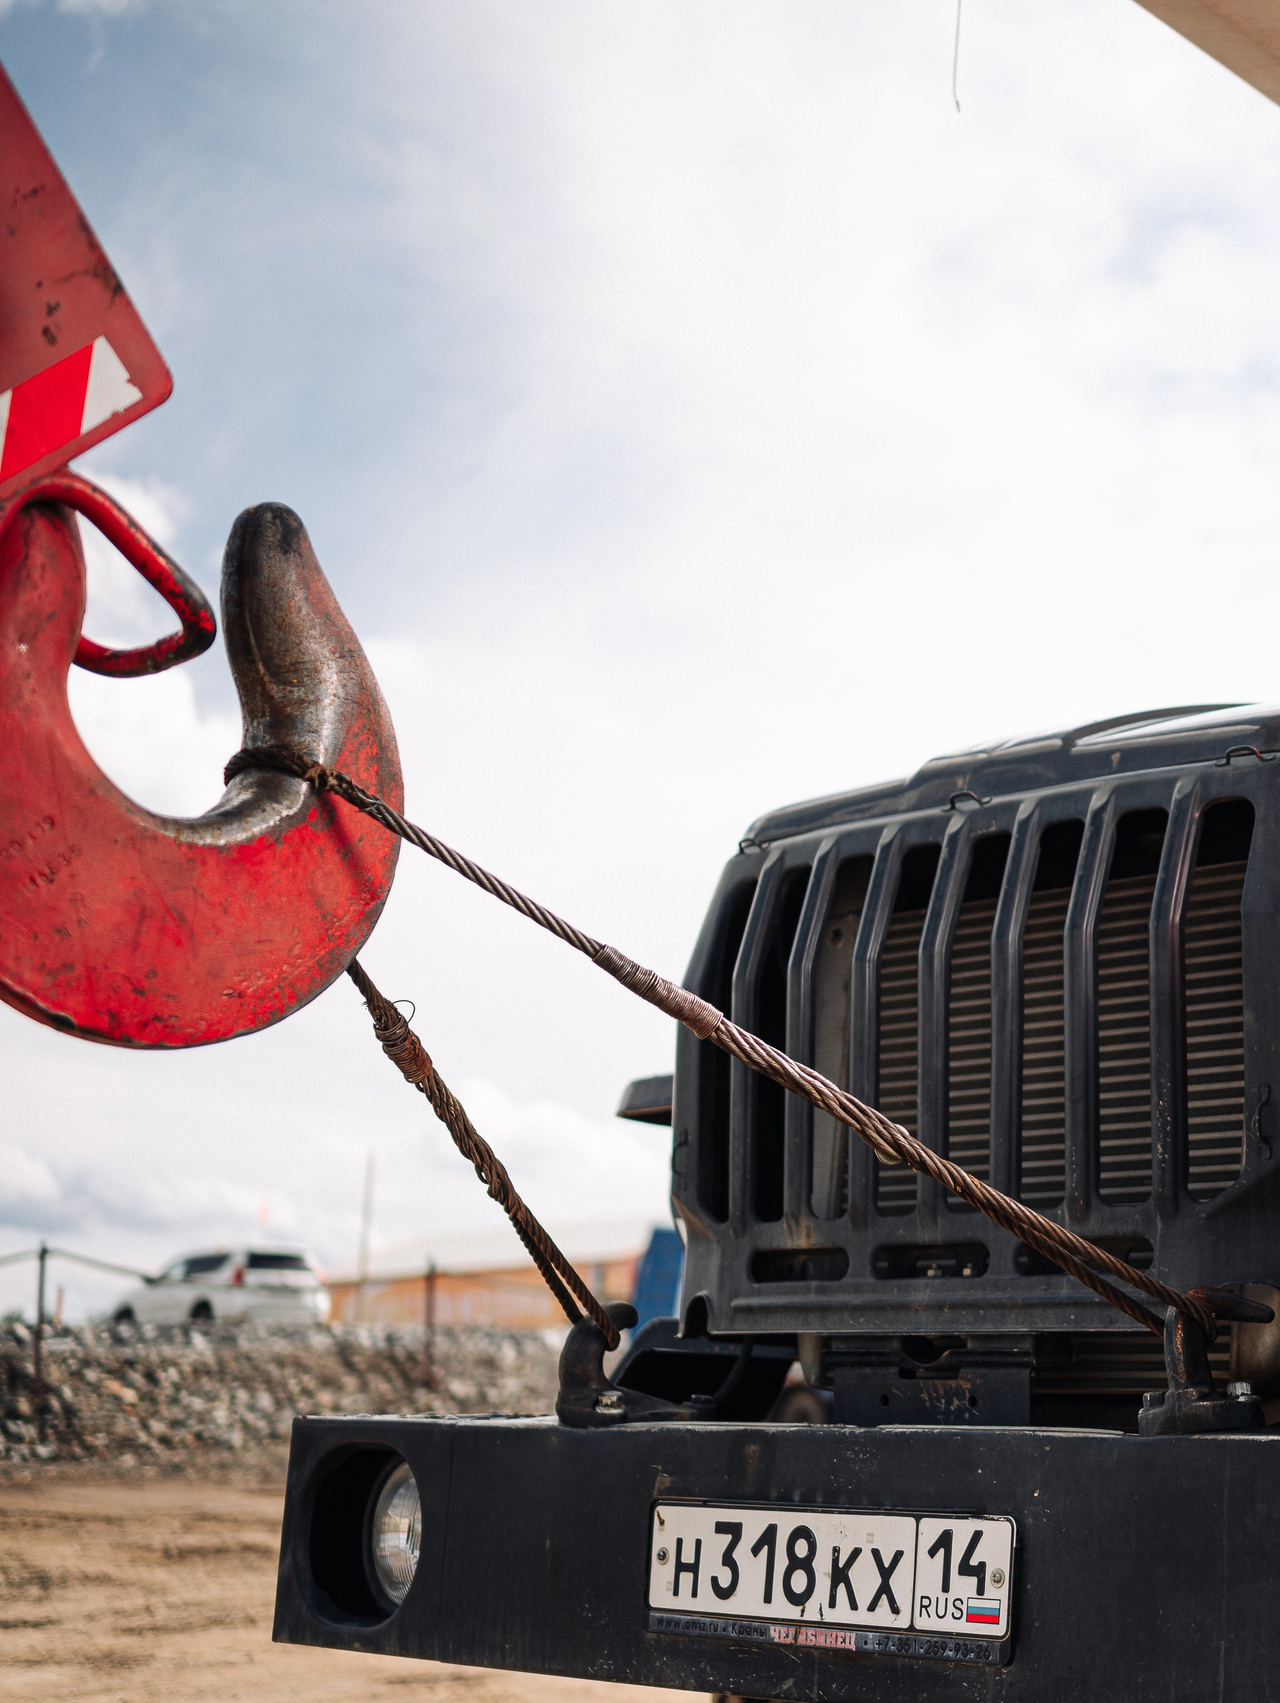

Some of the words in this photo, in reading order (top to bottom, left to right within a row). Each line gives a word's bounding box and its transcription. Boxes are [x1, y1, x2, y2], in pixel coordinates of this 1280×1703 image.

[672, 1520, 904, 1614] Н318КХ
[927, 1529, 986, 1596] 14
[919, 1595, 965, 1621] RUS
[732, 1622, 768, 1639] Краны
[875, 1636, 992, 1660] +7-351-259-93-26
